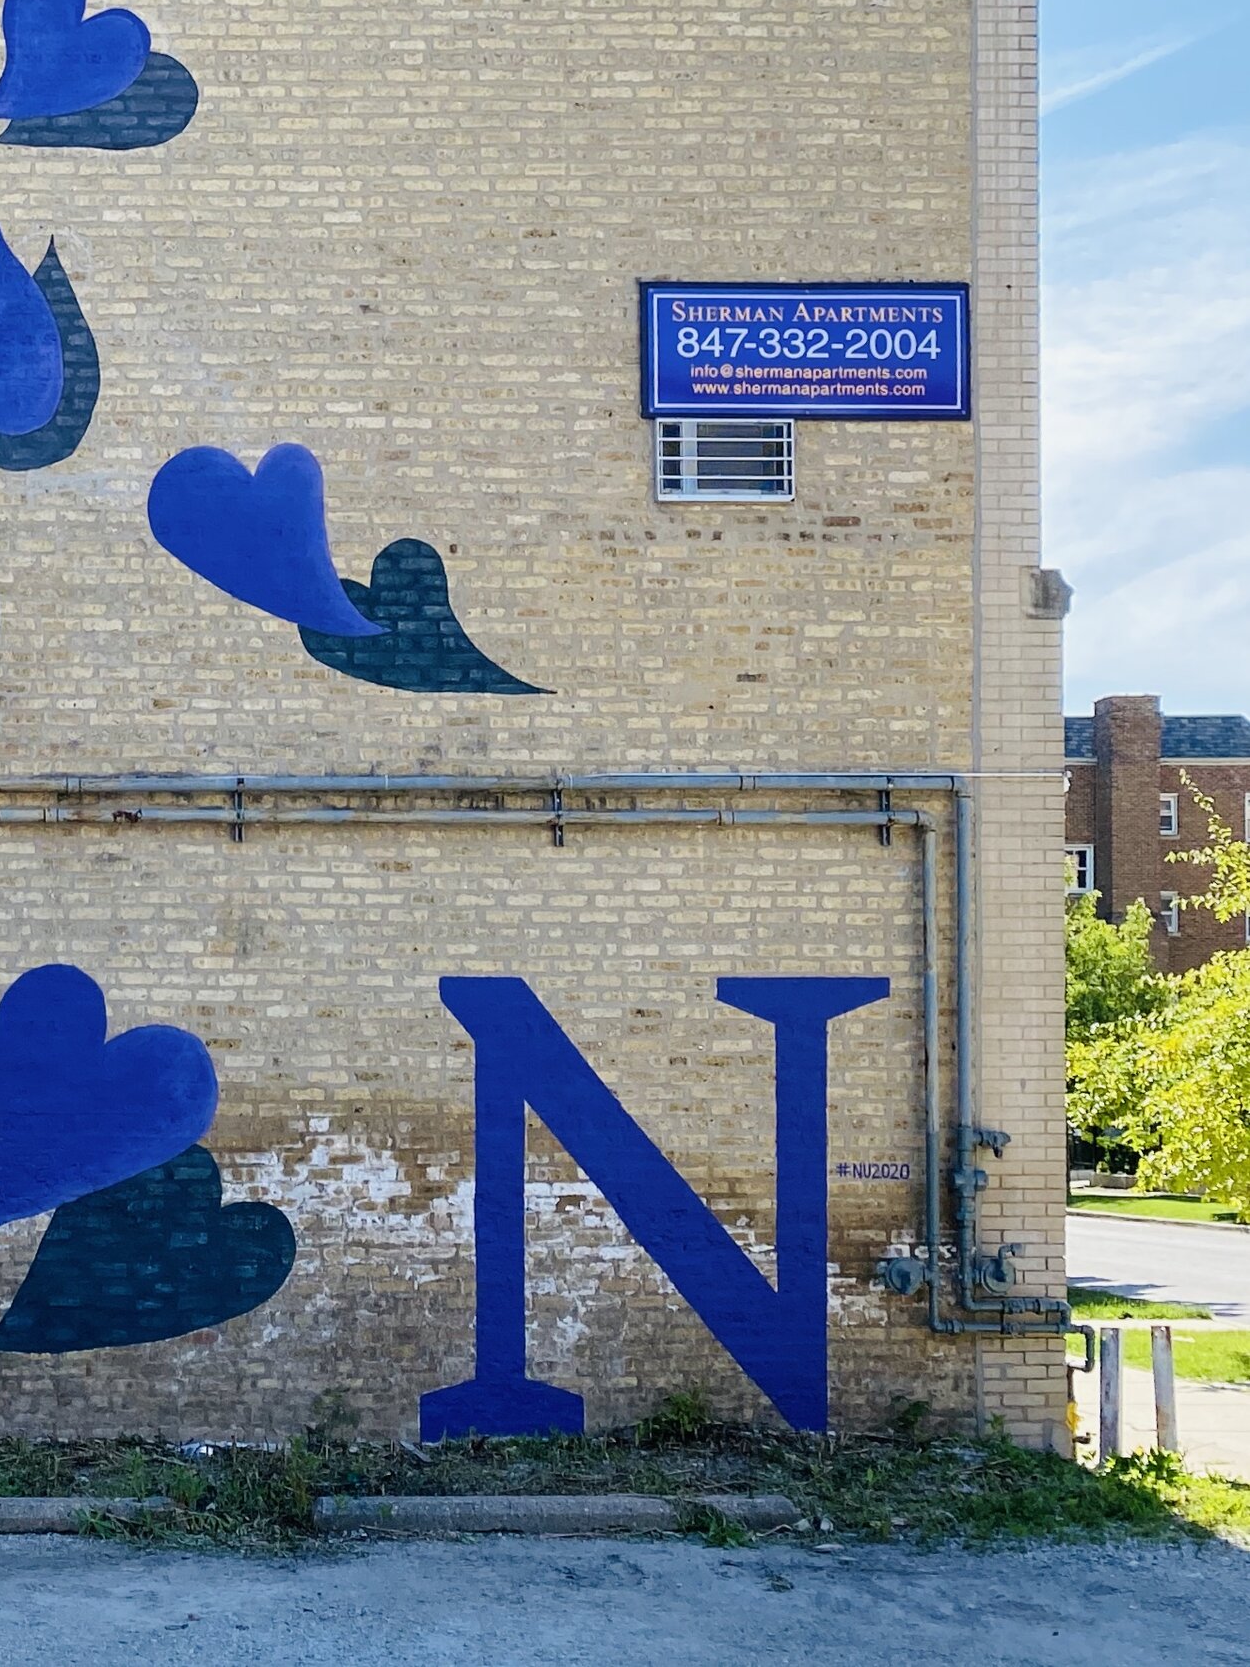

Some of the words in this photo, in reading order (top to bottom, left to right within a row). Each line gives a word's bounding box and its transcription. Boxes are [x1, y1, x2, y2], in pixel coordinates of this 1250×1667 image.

[676, 326, 941, 360] 847-332-2004
[690, 363, 927, 381] info@shermanapartments.com
[692, 382, 926, 398] www.shermanapartments.com
[836, 1162, 910, 1180] #NU2020
[420, 976, 890, 1442] N
